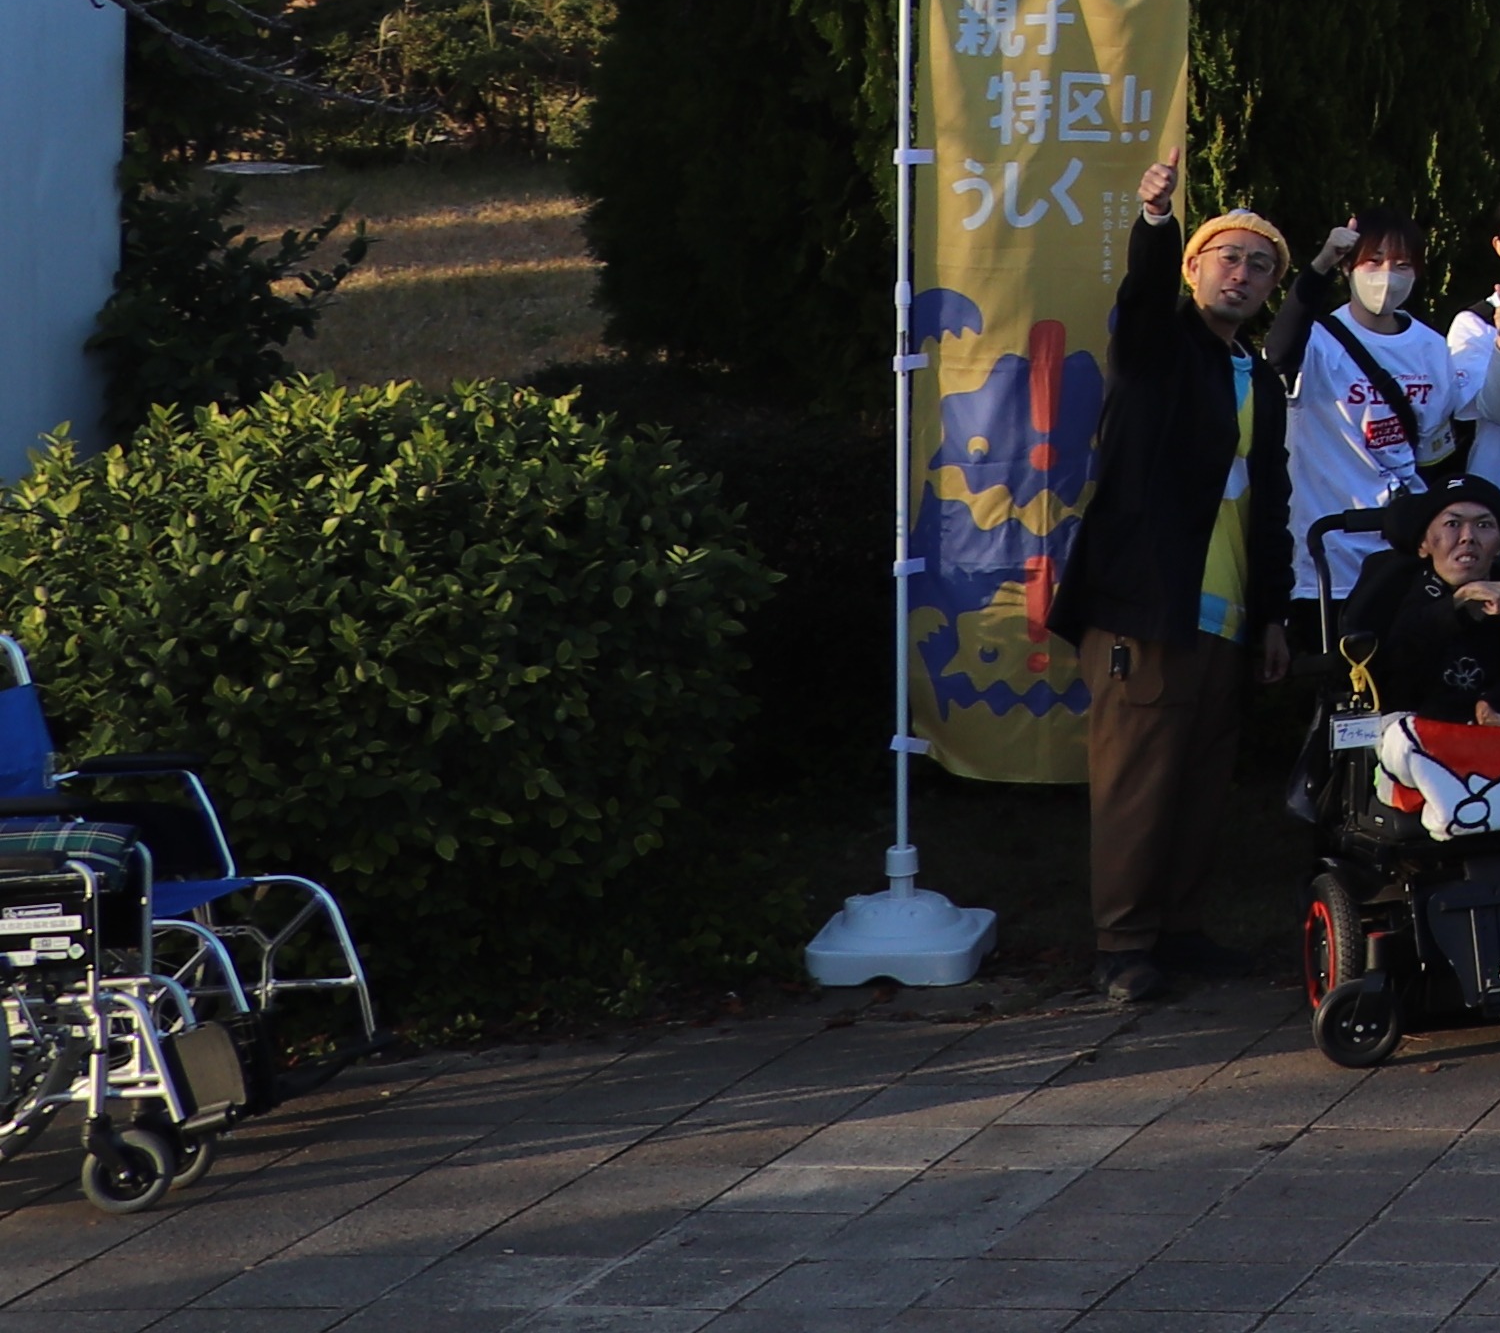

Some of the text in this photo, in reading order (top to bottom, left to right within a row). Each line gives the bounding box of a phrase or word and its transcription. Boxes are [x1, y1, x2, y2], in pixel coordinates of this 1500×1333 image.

[986, 69, 1152, 145] 特区!!
[952, 158, 1084, 231] うしく
[1118, 190, 1130, 230] ともに
[1102, 191, 1113, 284] 育ち合えるまち
